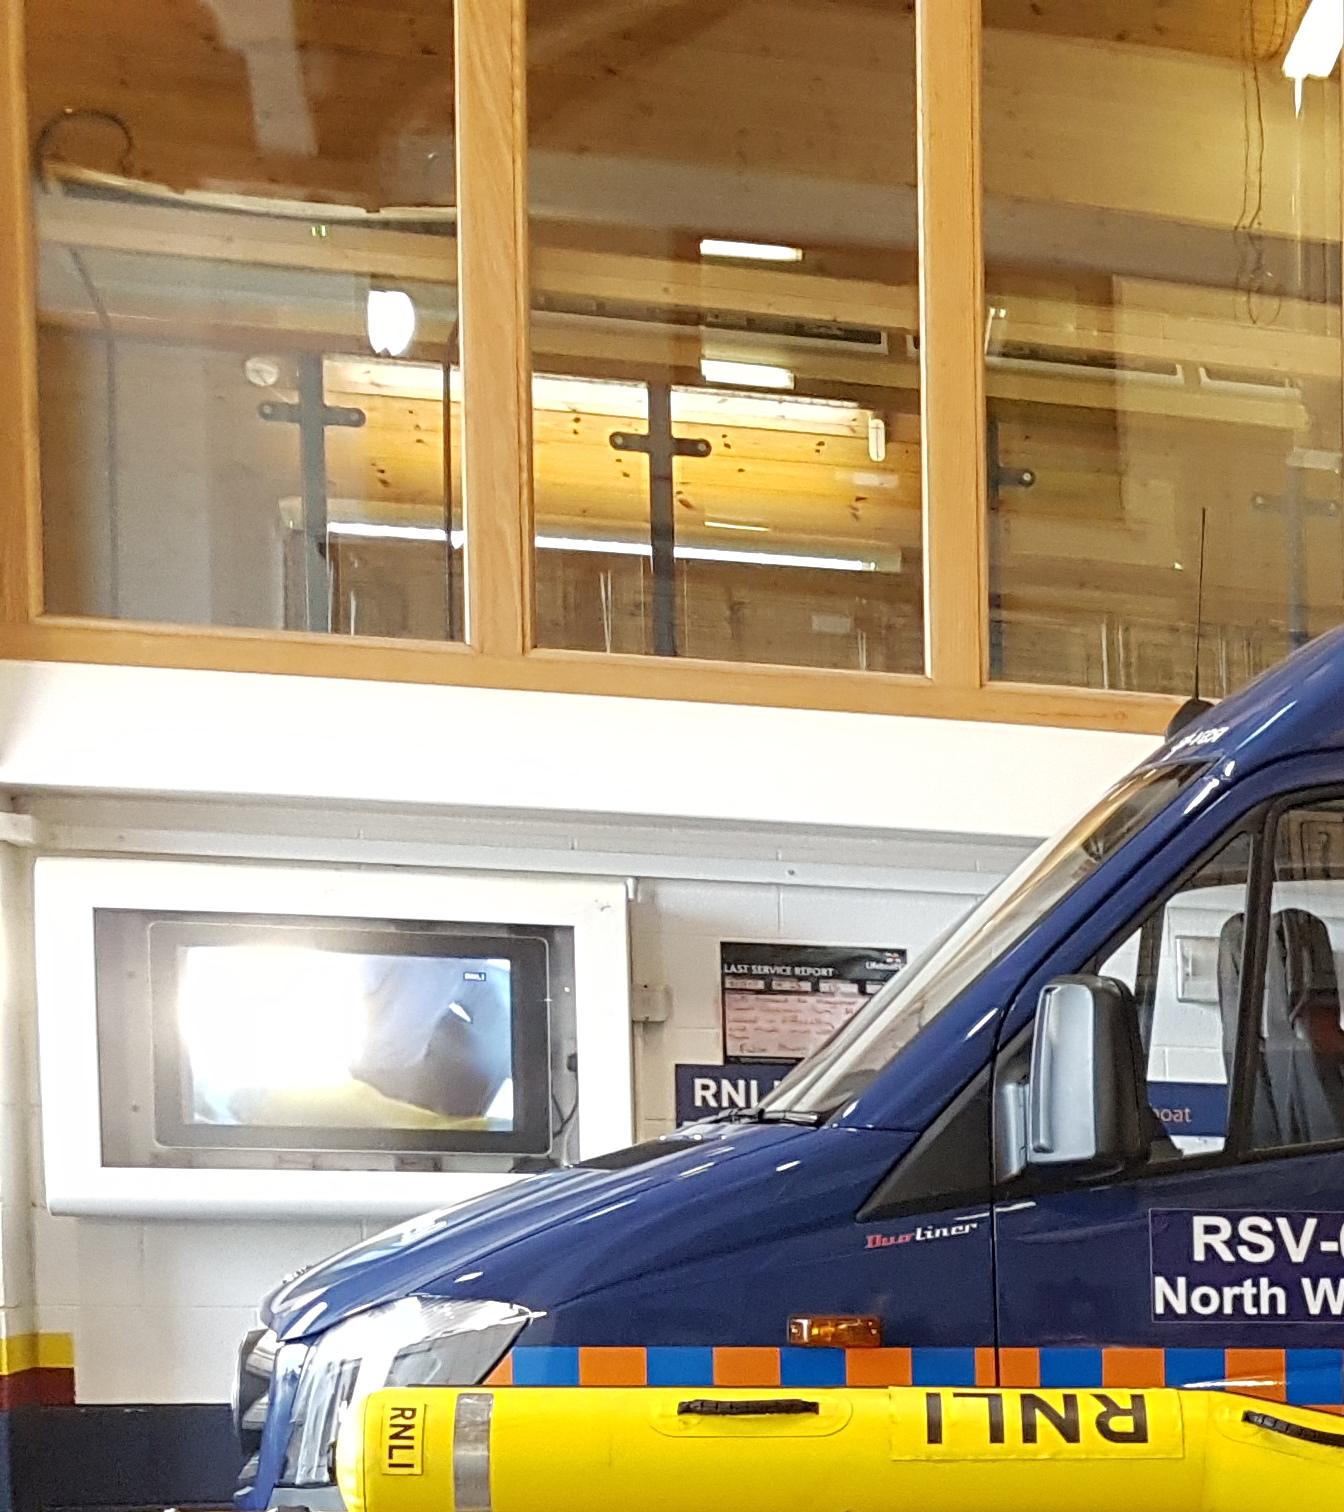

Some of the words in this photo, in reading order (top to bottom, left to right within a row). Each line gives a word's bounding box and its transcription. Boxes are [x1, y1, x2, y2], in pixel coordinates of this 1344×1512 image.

[724, 963, 748, 973] LAST
[751, 965, 792, 976] SERVICE
[794, 967, 835, 977] REPORT
[1153, 1275, 1287, 1317] North
[388, 1406, 417, 1469] RNLI
[926, 1392, 1149, 1445] RNLI
